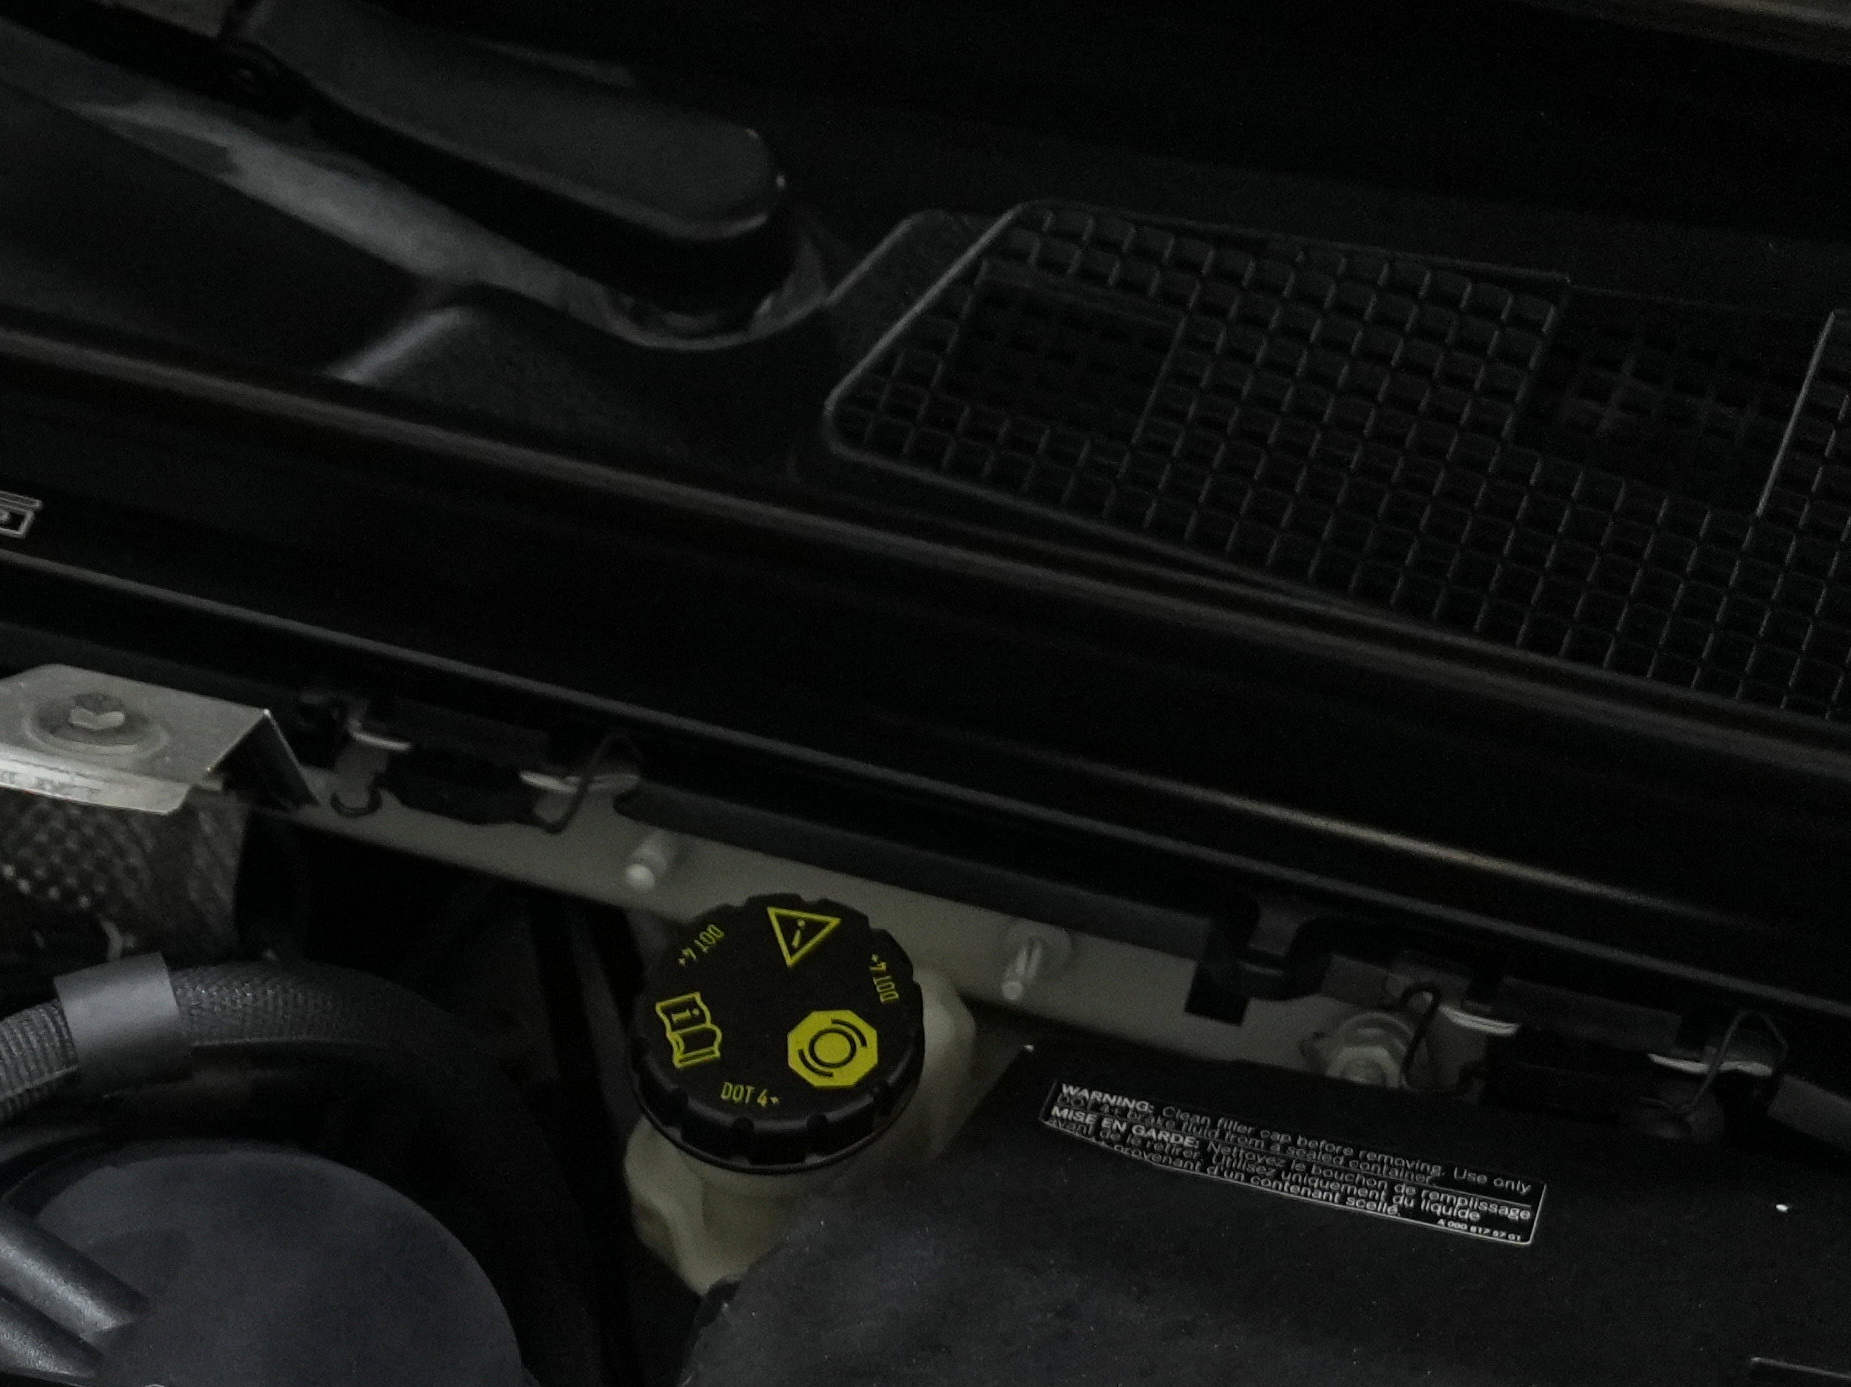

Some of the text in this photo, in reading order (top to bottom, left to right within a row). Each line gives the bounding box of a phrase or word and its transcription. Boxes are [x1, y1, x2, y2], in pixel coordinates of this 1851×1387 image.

[693, 923, 725, 954] DOT
[719, 1081, 755, 1106] DOT
[1061, 1083, 1155, 1114] WARNING:
[1162, 1106, 1211, 1125] Clean
[1217, 1116, 1256, 1136] filler
[1297, 1134, 1354, 1157] before
[1359, 1150, 1446, 1178] removing.
[1454, 1167, 1488, 1185] Use
[1493, 1177, 1532, 1196] only
[1225, 1127, 1265, 1149] from
[1051, 1105, 1097, 1125] MISE
[1101, 1118, 1127, 1133] EN
[1131, 1124, 1200, 1149] GARDE:
[1291, 1159, 1307, 1173] le
[1311, 1164, 1388, 1191] bouchon
[1394, 1183, 1417, 1197] de
[1421, 1189, 1531, 1221] remplissage
[1250, 1175, 1341, 1204] contenant
[1281, 1170, 1387, 1203] uniquement
[1392, 1194, 1415, 1209] du
[1421, 1198, 1481, 1222] liquide
